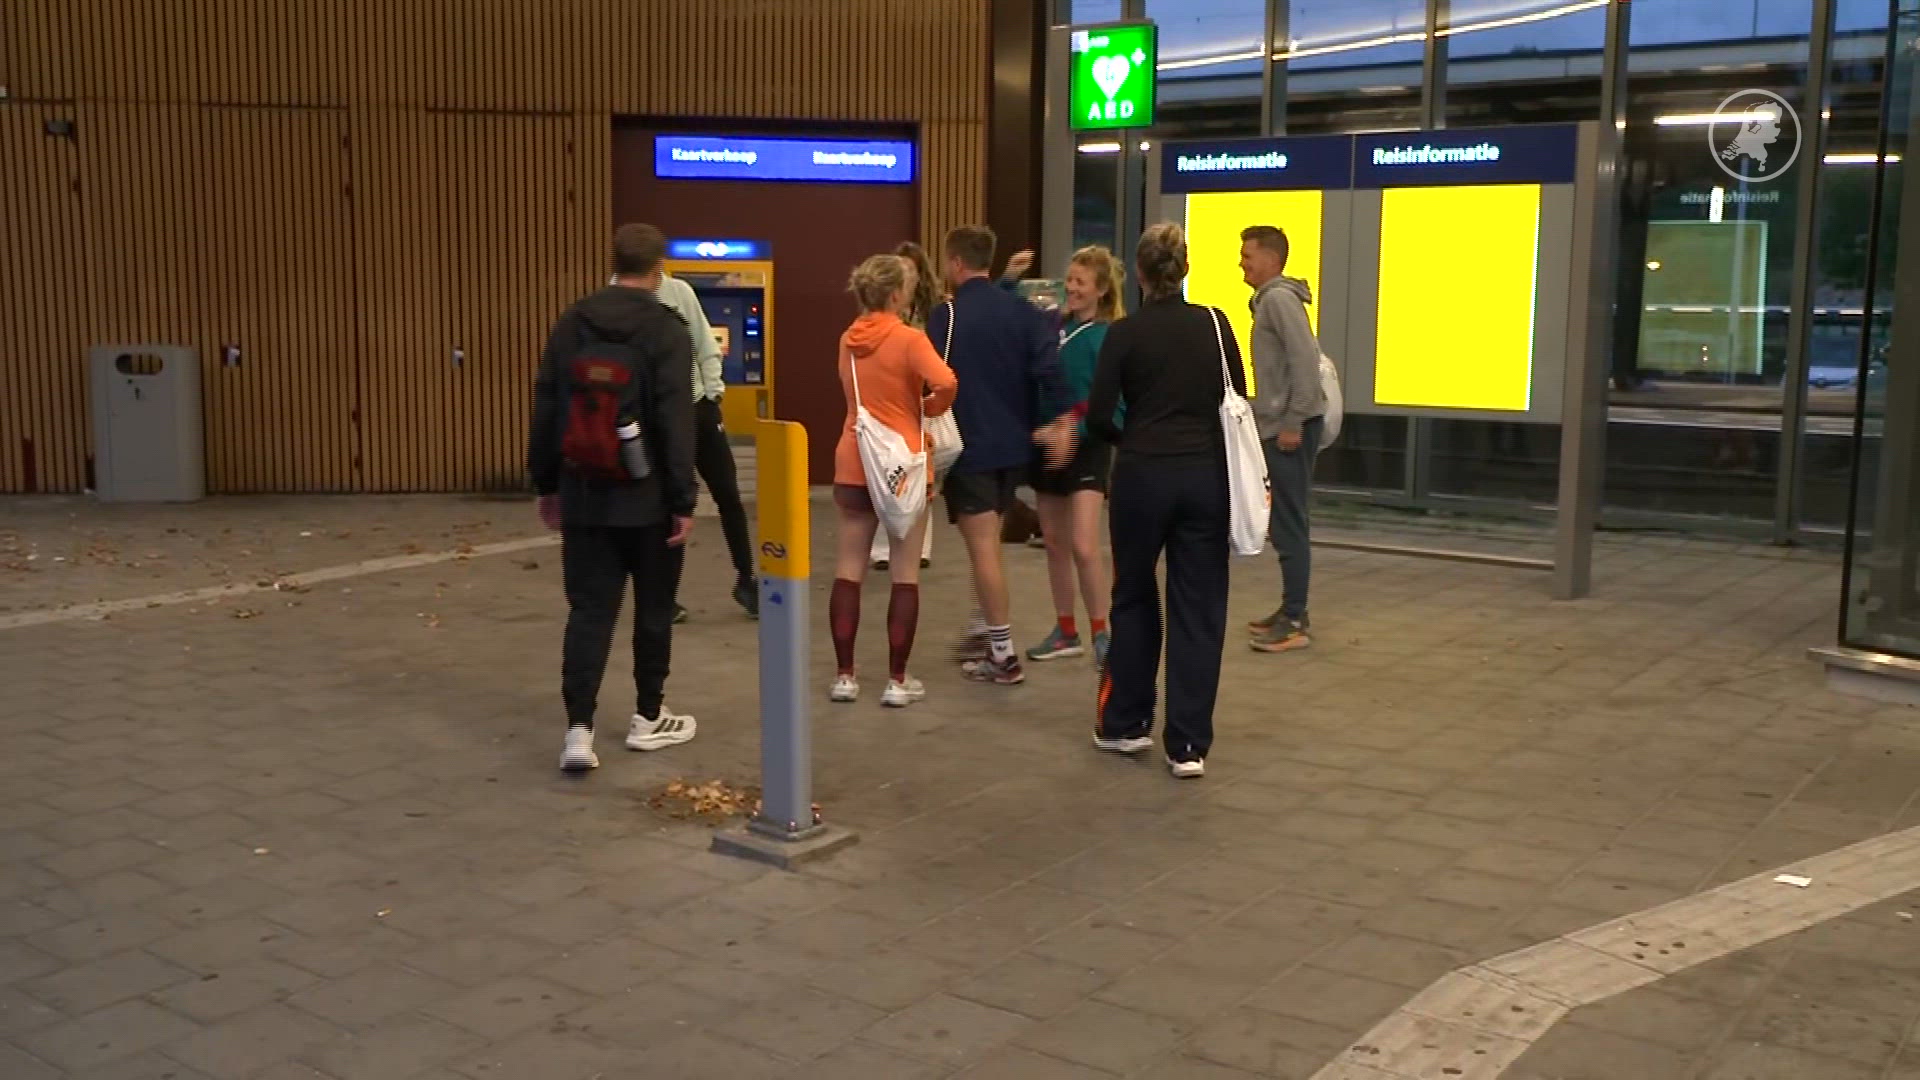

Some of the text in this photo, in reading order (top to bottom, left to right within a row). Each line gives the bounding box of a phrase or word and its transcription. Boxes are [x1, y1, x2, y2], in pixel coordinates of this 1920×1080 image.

[1088, 100, 1135, 121] AED
[1178, 152, 1288, 172] Reisinformatie
[1372, 143, 1500, 164] Reisinformatie
